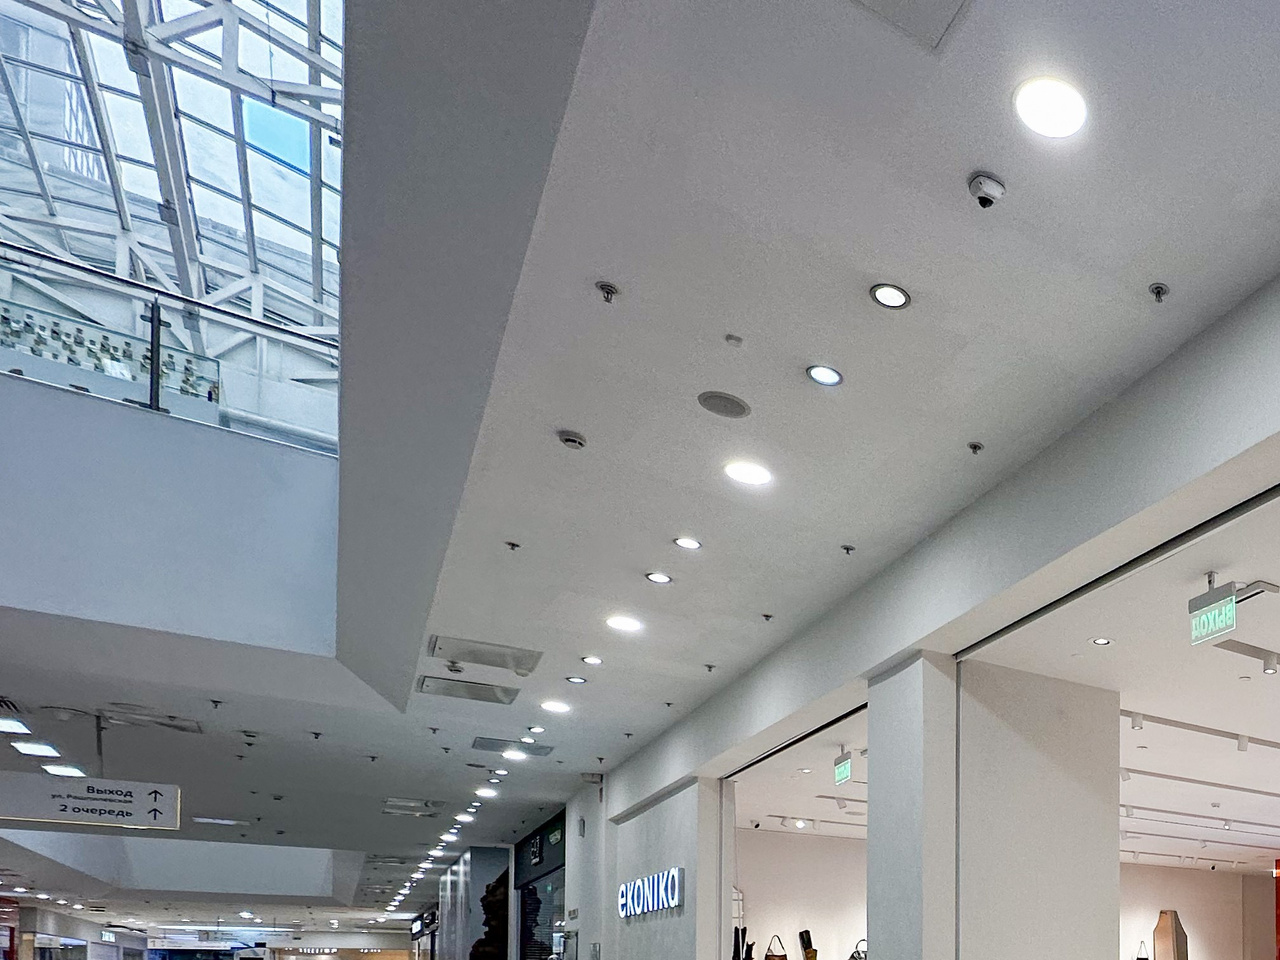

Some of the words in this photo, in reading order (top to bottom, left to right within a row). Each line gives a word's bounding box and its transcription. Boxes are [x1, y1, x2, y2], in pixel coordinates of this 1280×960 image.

[86, 785, 134, 798] Выход
[59, 804, 68, 812] 2
[72, 806, 133, 818] очередь
